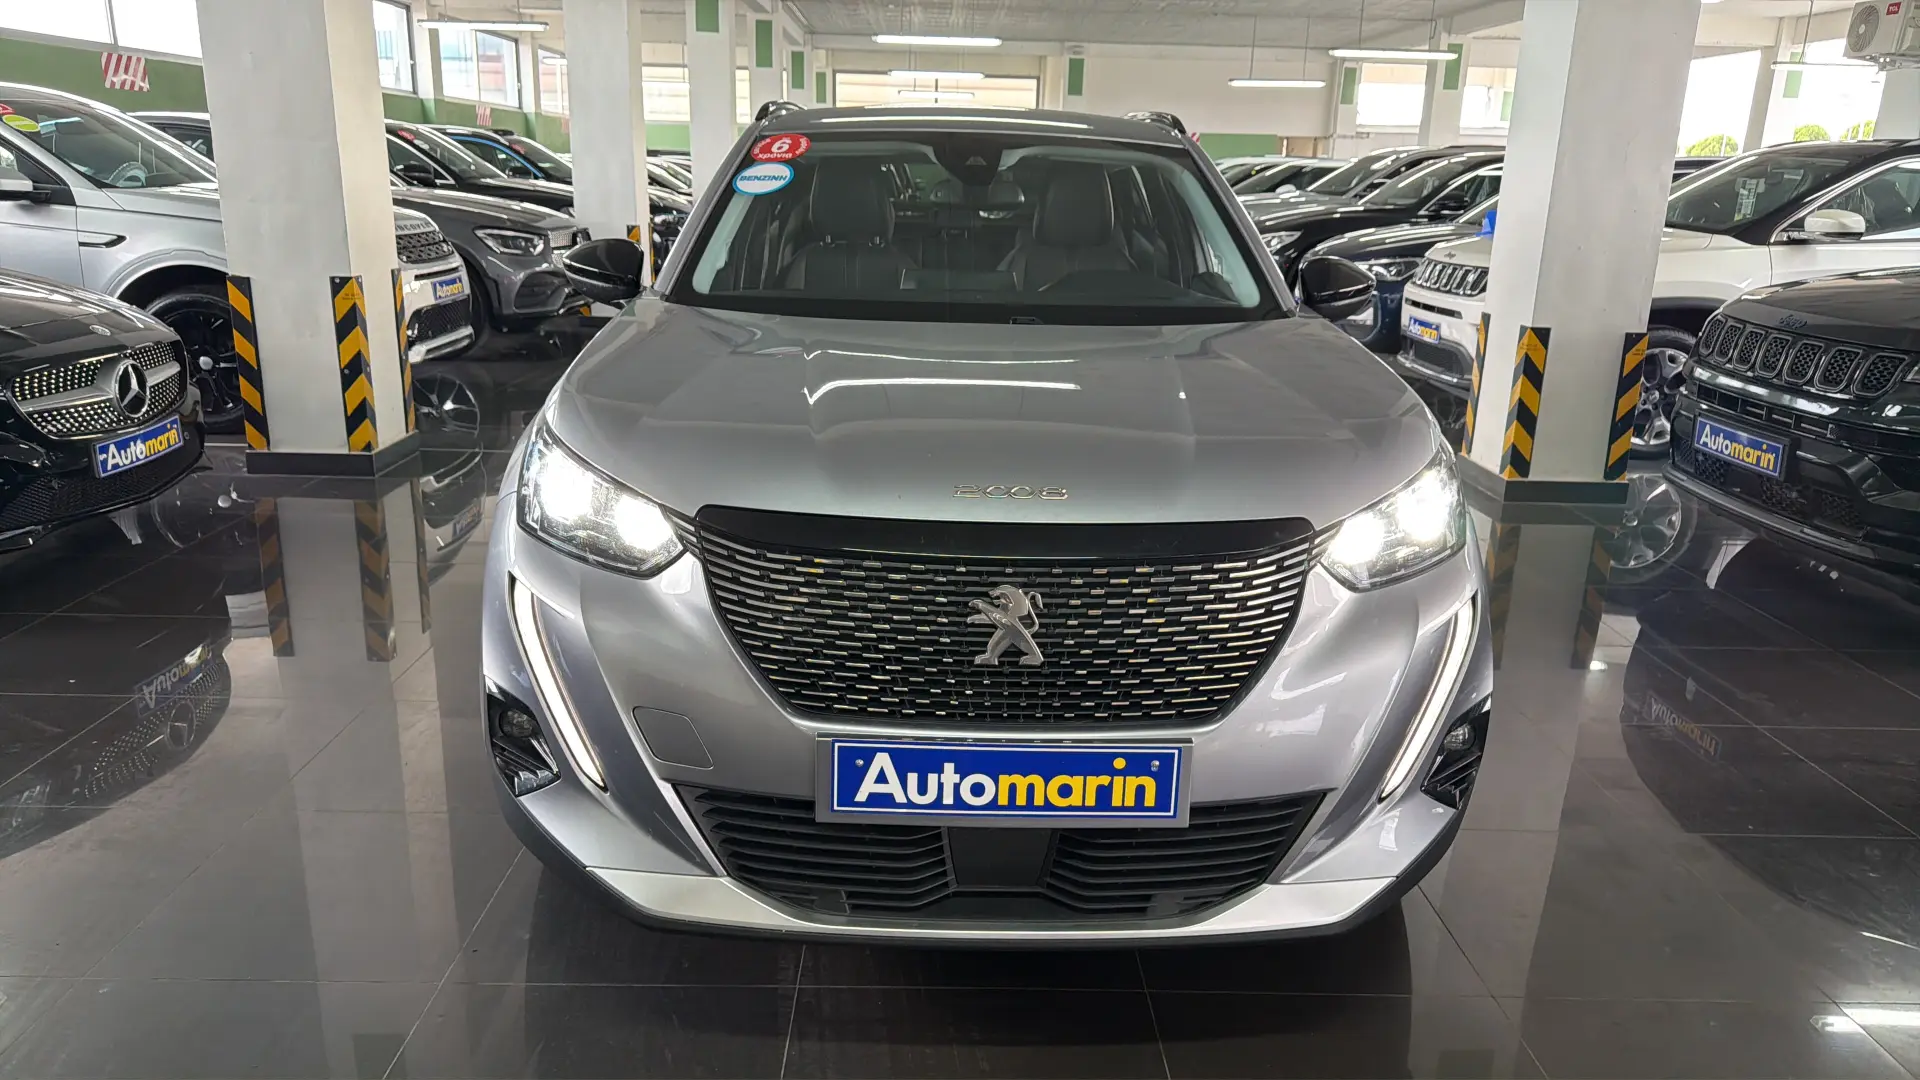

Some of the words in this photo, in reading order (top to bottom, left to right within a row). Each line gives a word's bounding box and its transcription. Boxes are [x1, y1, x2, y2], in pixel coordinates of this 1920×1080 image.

[771, 138, 792, 153] 6
[107, 423, 179, 471] Automarin
[1699, 424, 1776, 471] Automarin
[952, 484, 1068, 500] 2008
[853, 752, 1157, 807] Automarin
